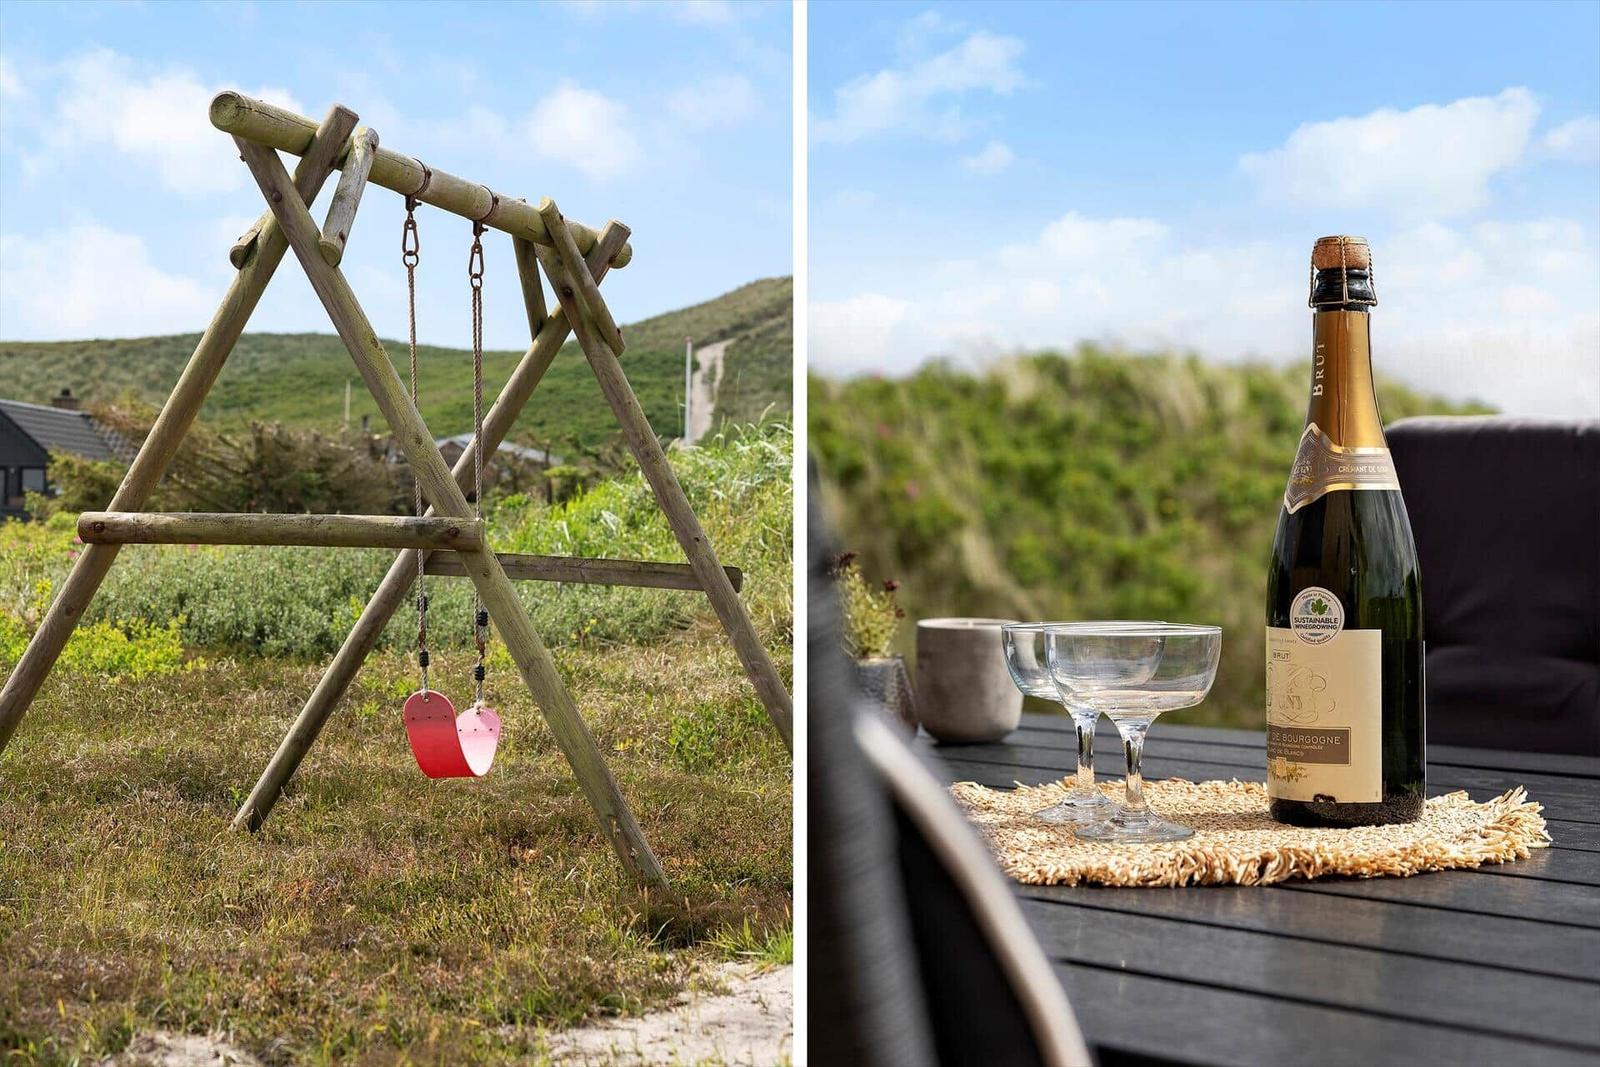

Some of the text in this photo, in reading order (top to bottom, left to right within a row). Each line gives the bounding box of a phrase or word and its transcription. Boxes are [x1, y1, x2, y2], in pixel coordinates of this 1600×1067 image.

[1313, 343, 1325, 396] BRUT
[1273, 652, 1289, 660] BRUT
[1282, 733, 1341, 745] BOURGOGNE
